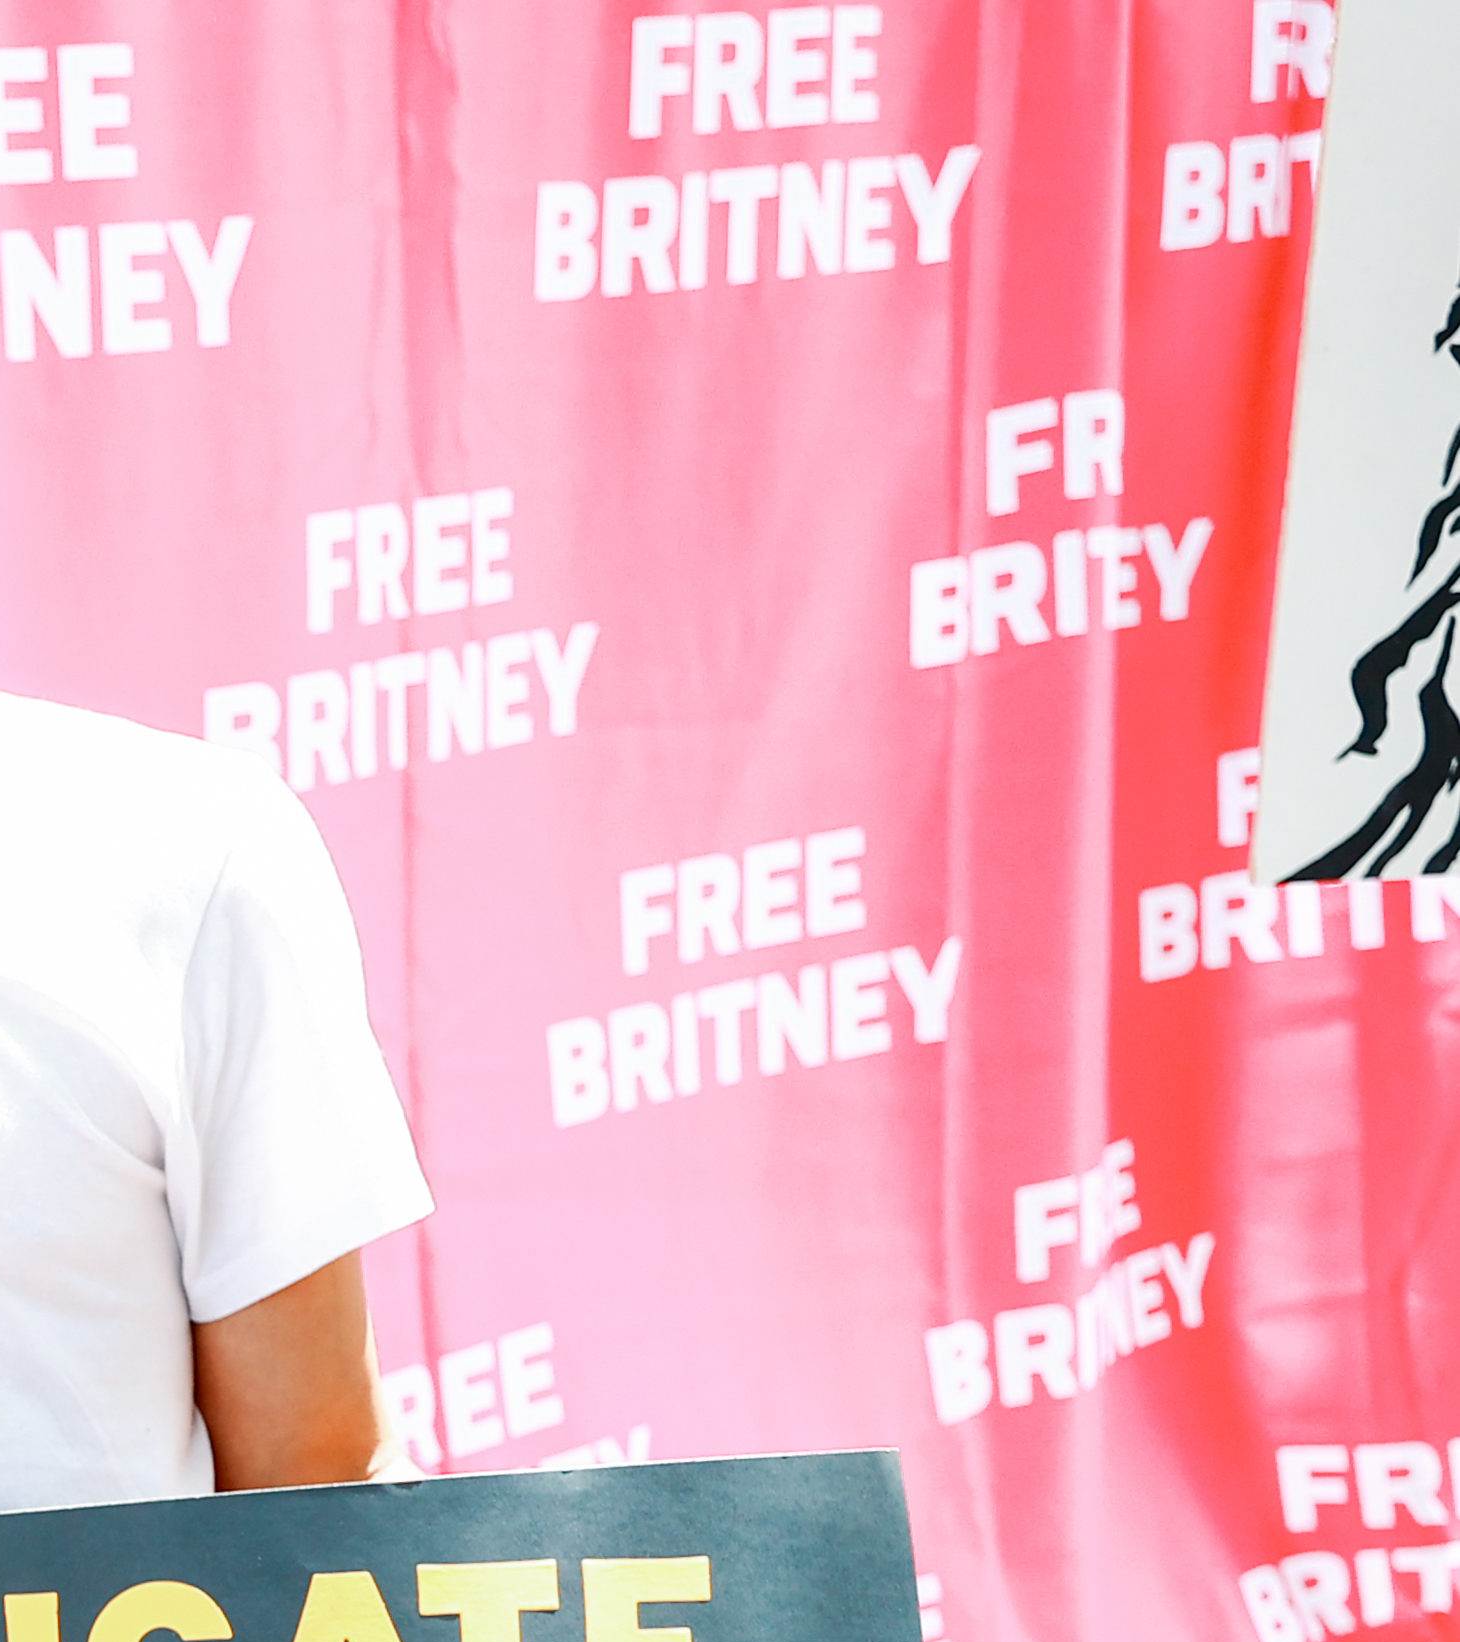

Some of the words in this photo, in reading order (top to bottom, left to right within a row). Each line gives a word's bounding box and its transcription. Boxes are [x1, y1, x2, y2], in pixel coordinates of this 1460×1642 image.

[629, 4, 882, 140] FREE
[534, 144, 982, 302] BRITNEY
[986, 388, 1125, 518] FR
[306, 486, 514, 635] FREE
[203, 620, 600, 794] BRITNEY
[619, 825, 866, 977] FREE
[546, 936, 963, 1128] BRITNEY
[380, 1322, 565, 1469] REE
